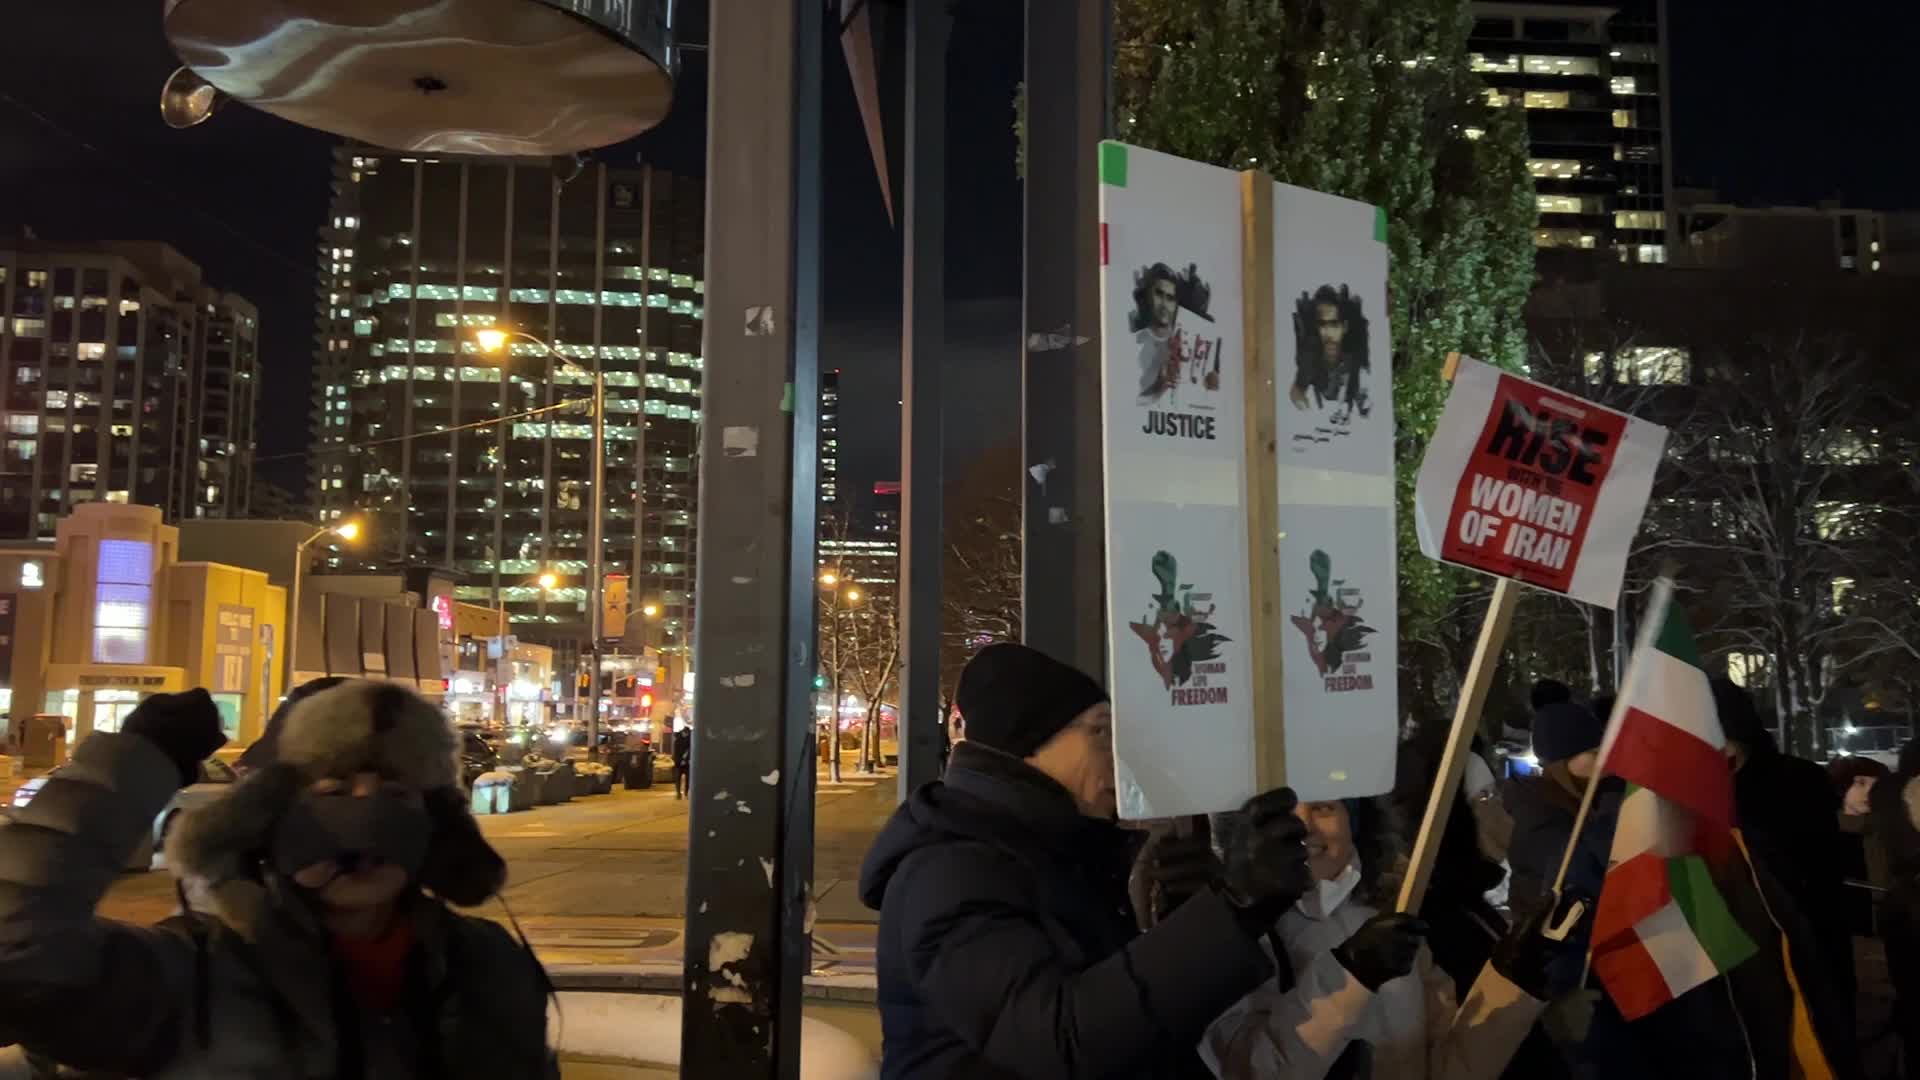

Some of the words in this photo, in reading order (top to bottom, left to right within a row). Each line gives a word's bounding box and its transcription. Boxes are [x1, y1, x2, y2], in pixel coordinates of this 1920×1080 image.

[1142, 409, 1217, 440] JUSTICE
[1487, 399, 1609, 485] RISE
[1470, 474, 1582, 537] WOMEN
[1459, 510, 1502, 547] OF
[1503, 522, 1573, 570] IRAN
[1171, 687, 1228, 707] FREEDOM
